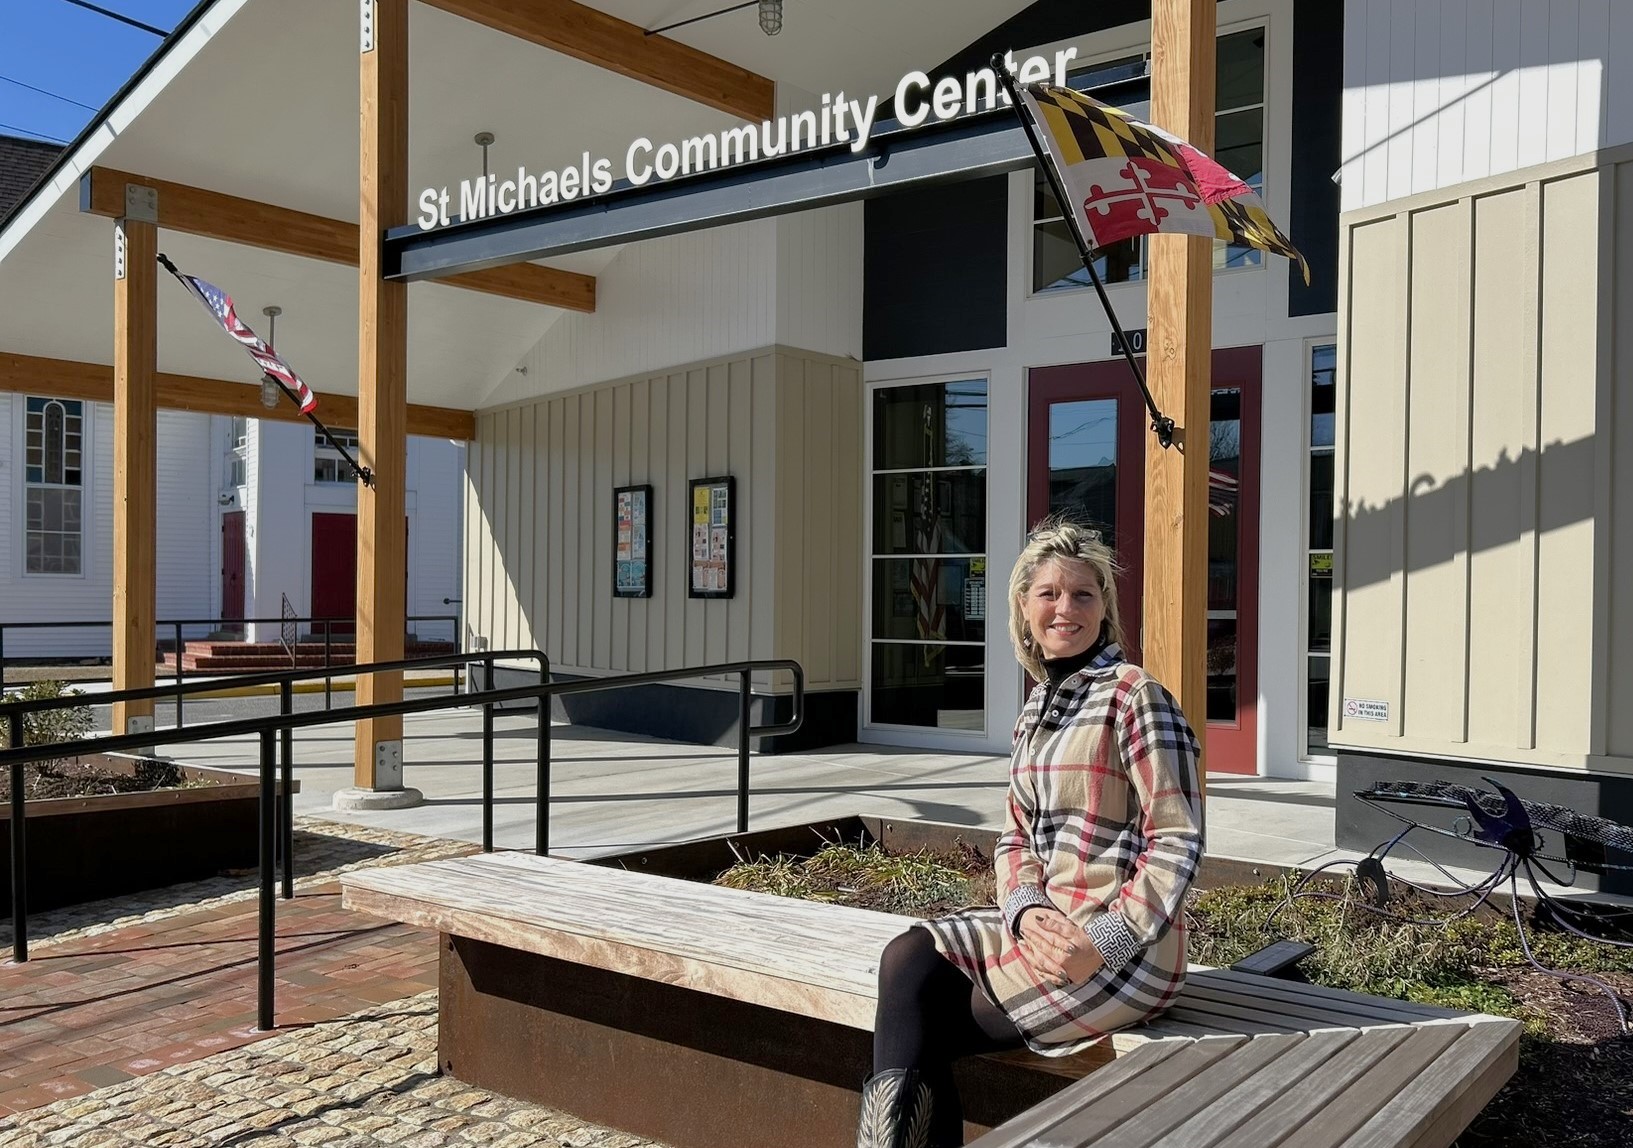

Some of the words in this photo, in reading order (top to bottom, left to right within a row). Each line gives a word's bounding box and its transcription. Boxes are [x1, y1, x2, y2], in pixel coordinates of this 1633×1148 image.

[418, 186, 450, 231] St
[460, 151, 613, 222] Michaels
[625, 90, 878, 186] Community
